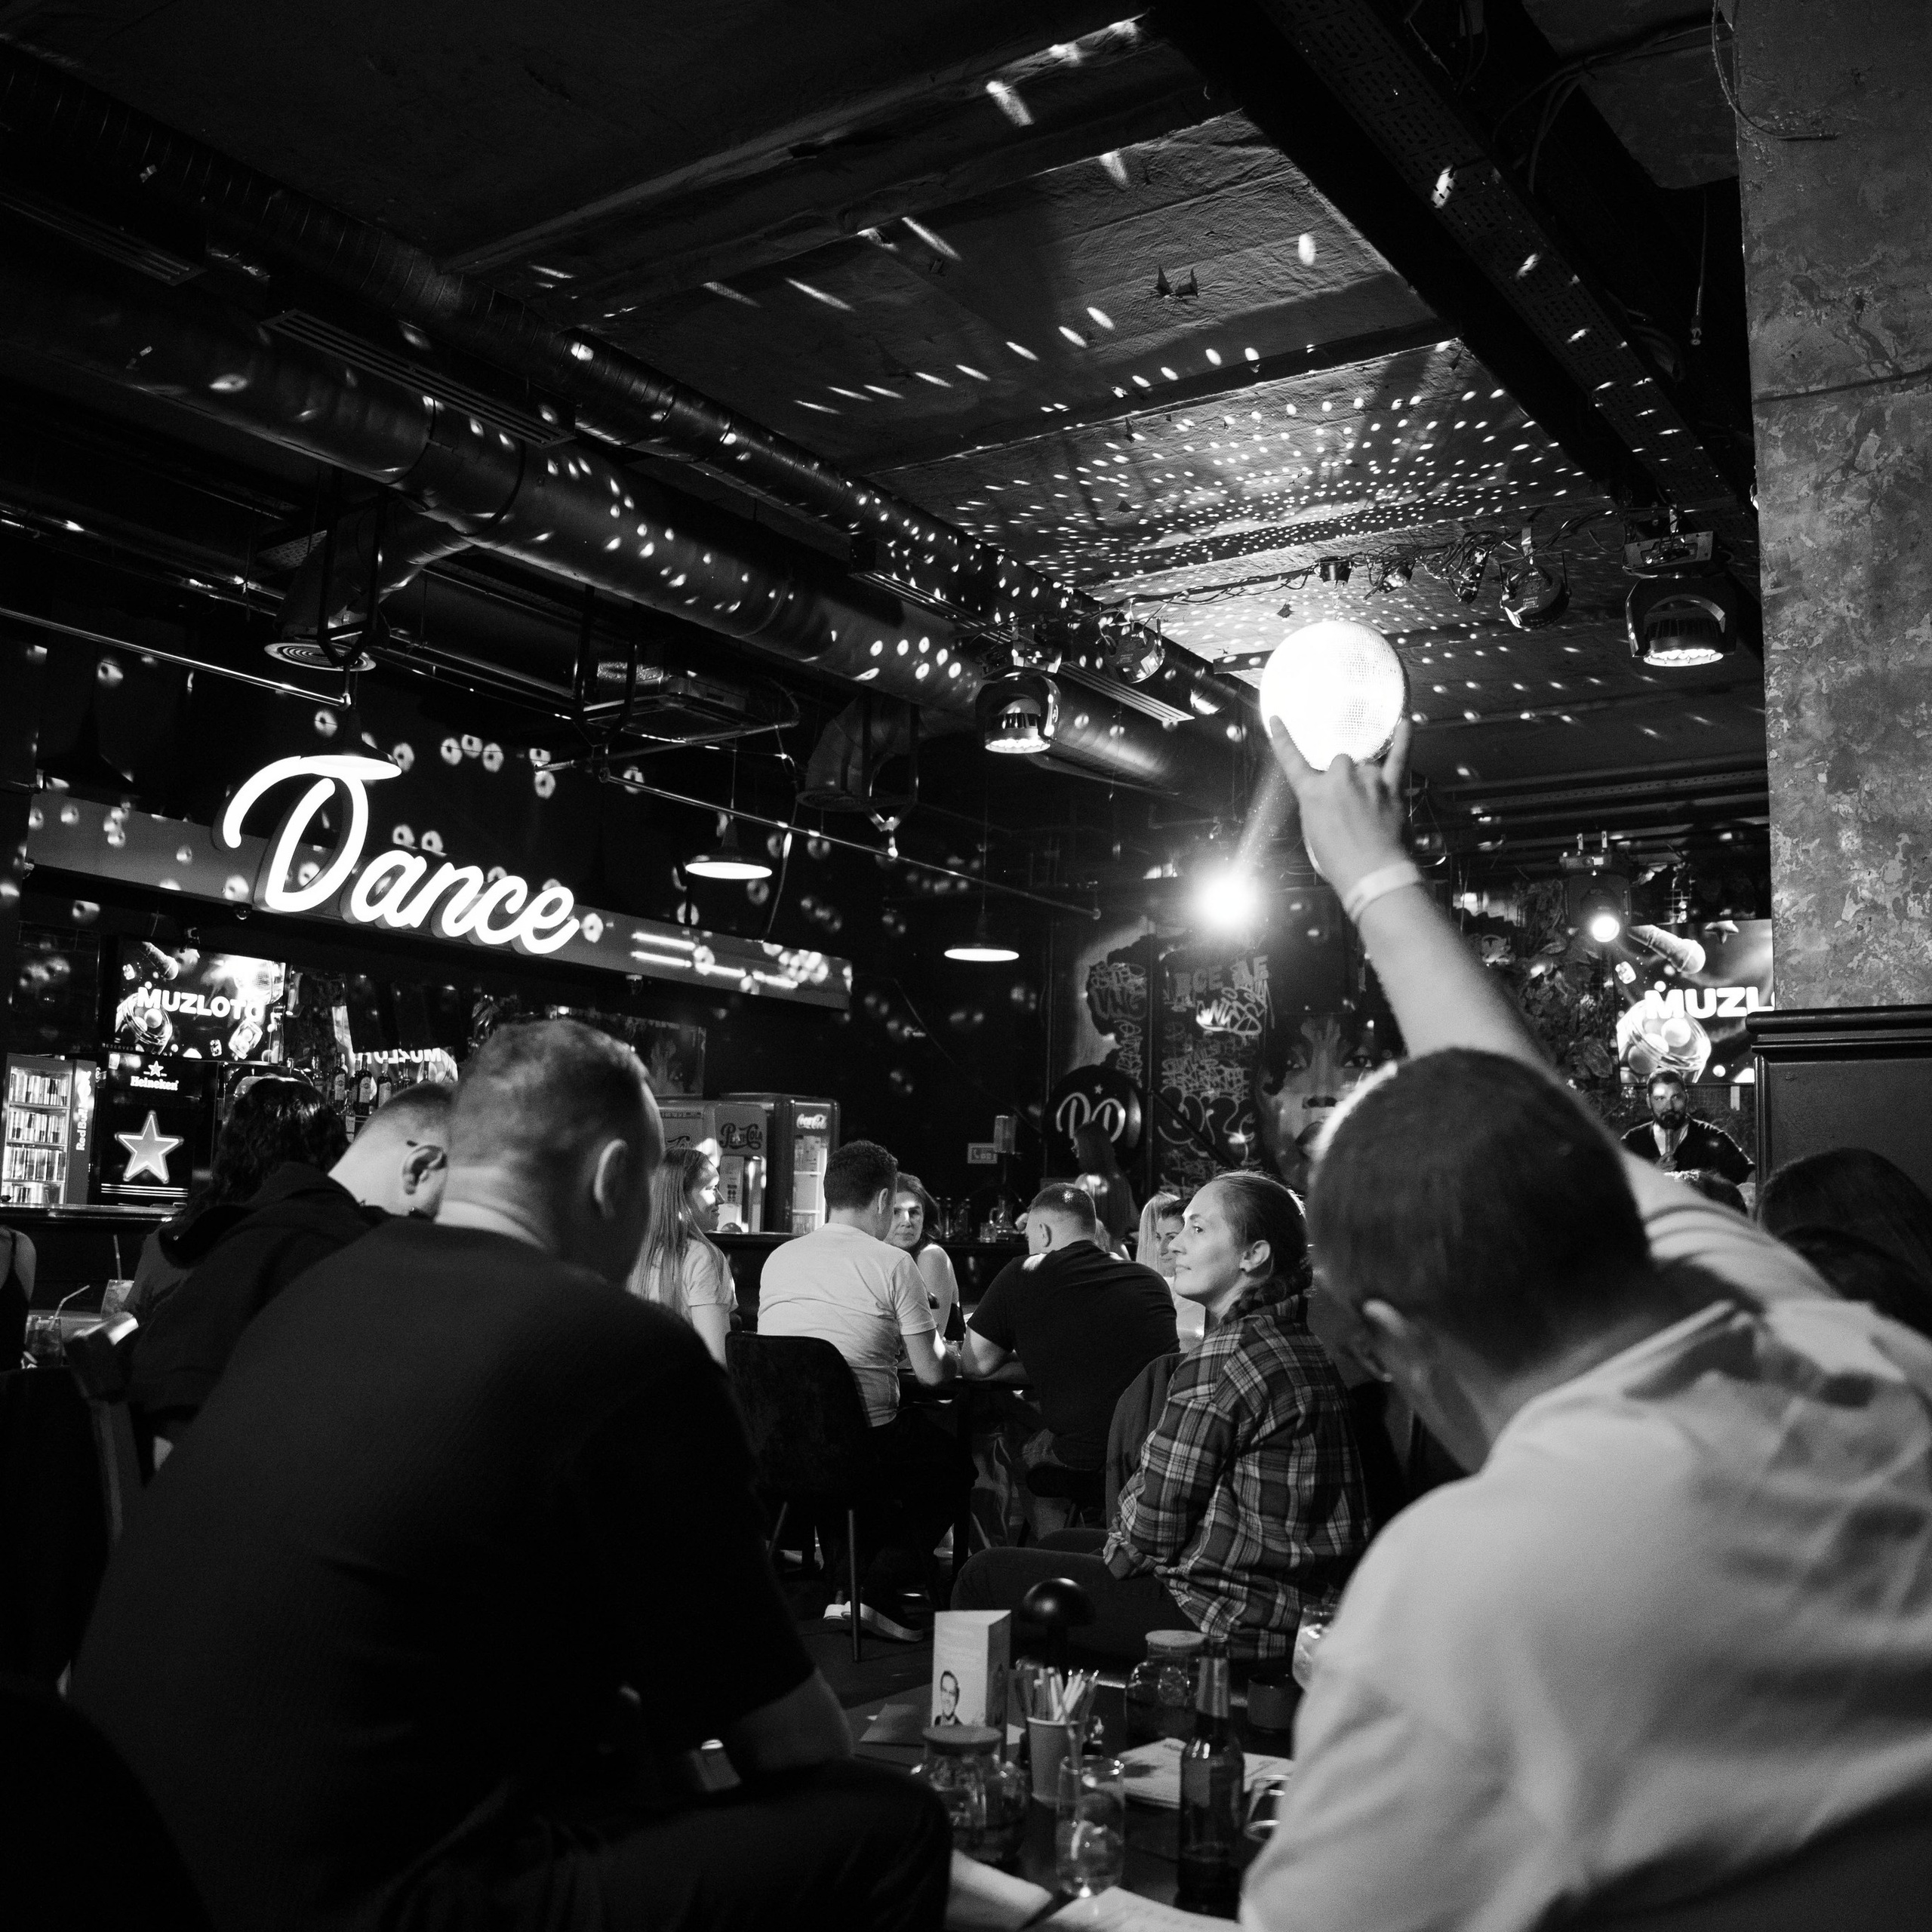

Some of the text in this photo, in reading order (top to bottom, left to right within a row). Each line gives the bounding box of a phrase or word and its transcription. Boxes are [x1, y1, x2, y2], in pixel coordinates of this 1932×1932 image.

[222, 755, 580, 955] Dance
[137, 986, 263, 1023] MUZLOTO
[1644, 986, 1775, 1020] MUZL
[130, 1075, 179, 1091] Heineken
[76, 1129, 87, 1151] Red
